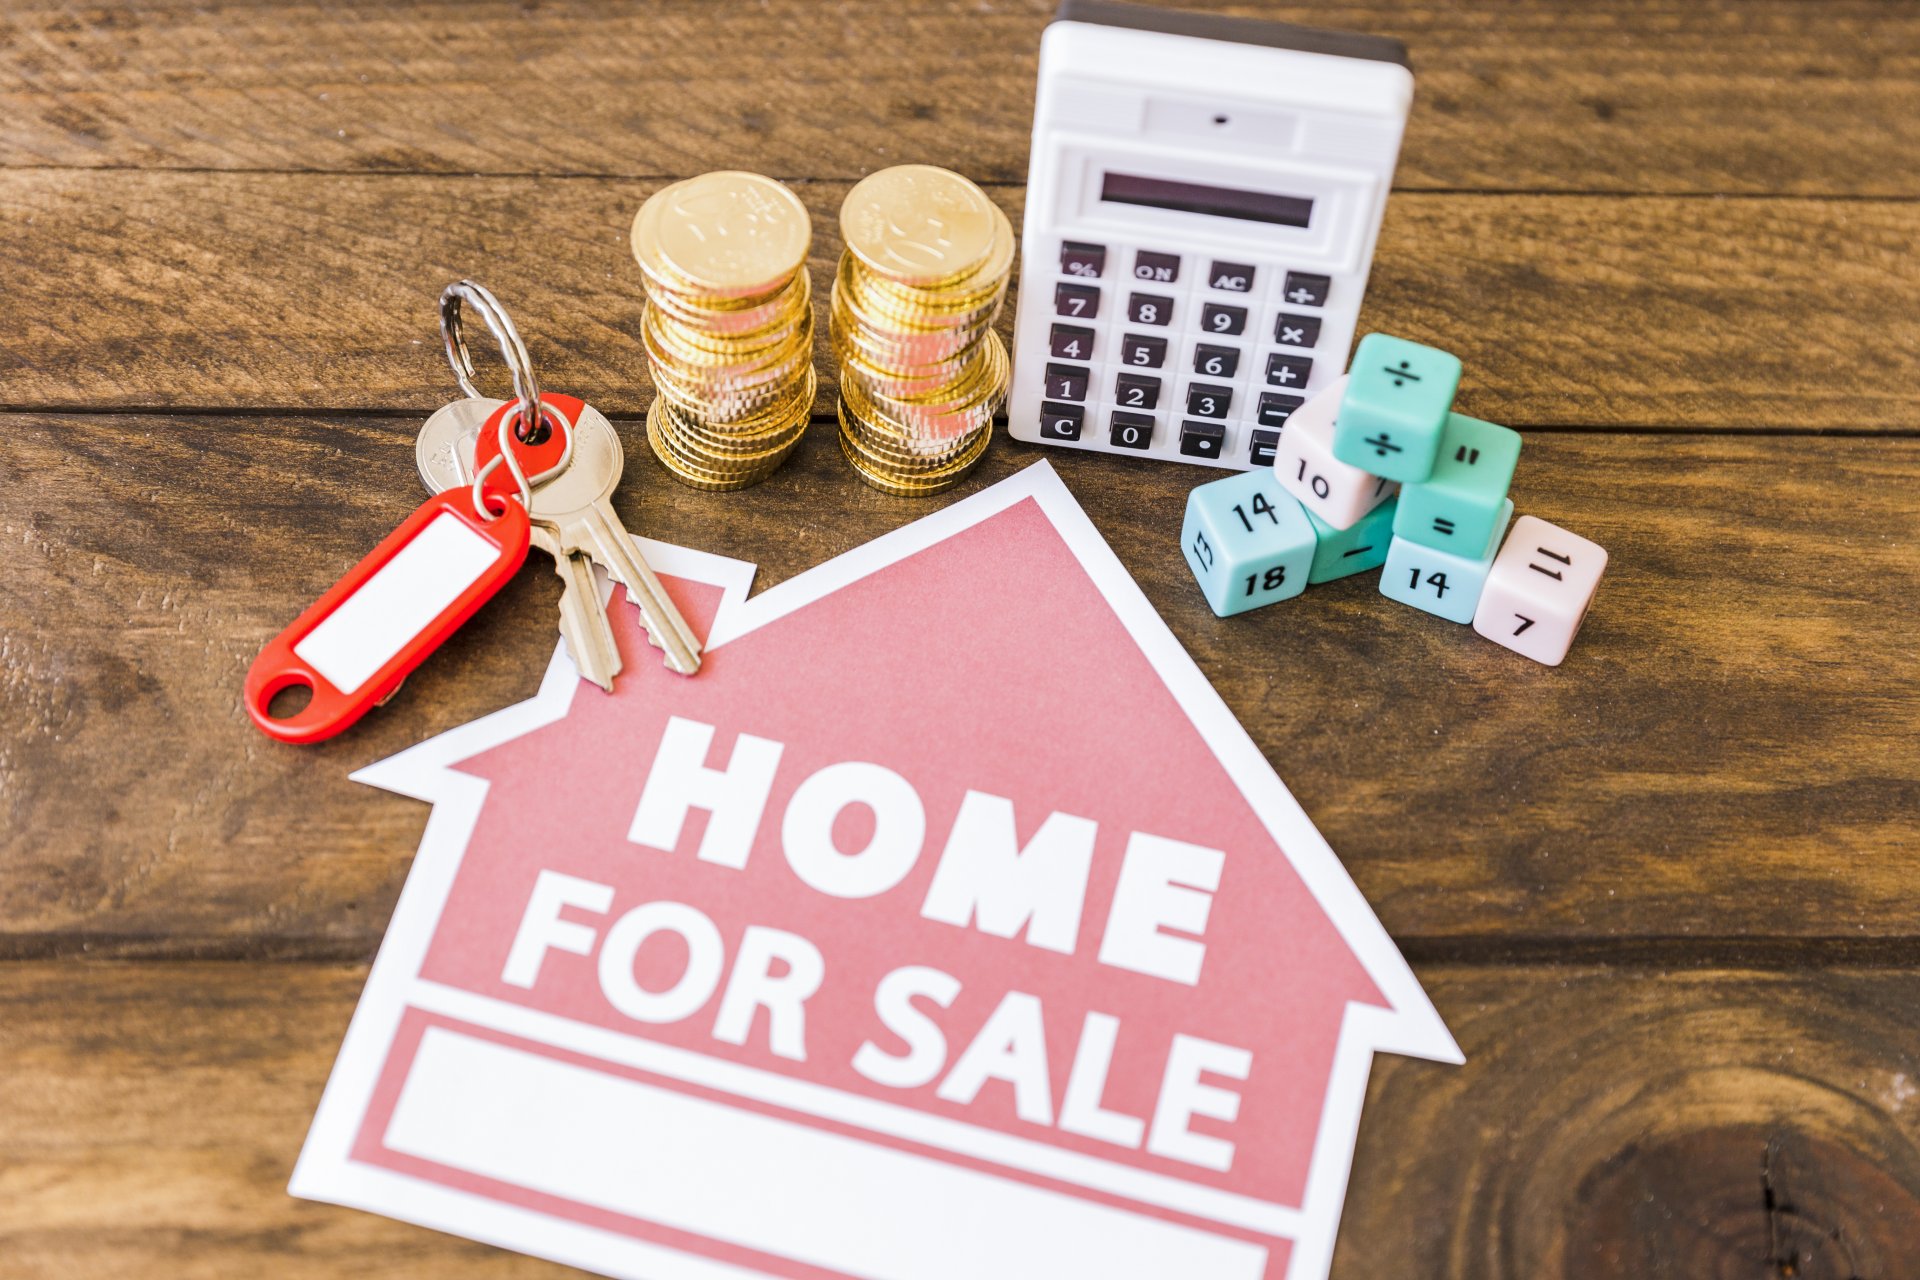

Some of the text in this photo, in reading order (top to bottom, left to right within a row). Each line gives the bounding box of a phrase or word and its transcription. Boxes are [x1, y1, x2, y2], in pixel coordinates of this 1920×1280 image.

[1136, 265, 1173, 281] ON
[1213, 275, 1247, 291] AC
[1068, 298, 1087, 316] 7
[1138, 304, 1157, 323] 8
[1213, 313, 1232, 332] 9
[1063, 340, 1080, 358] 4
[1133, 347, 1150, 365] 5
[1205, 357, 1222, 374] 6
[1060, 380, 1072, 398] 1
[1126, 388, 1144, 406] 2
[1199, 397, 1215, 415] 3
[1054, 419, 1074, 435] C
[1122, 427, 1139, 443] 0
[1298, 458, 1329, 500] 10
[1232, 492, 1279, 532] 14
[1245, 566, 1286, 597] 18
[1529, 547, 1571, 582] 11
[1410, 568, 1450, 599] 14
[1513, 613, 1535, 637] 7
[626, 715, 1226, 986] HOME
[500, 868, 1254, 1172] FOR SALE
